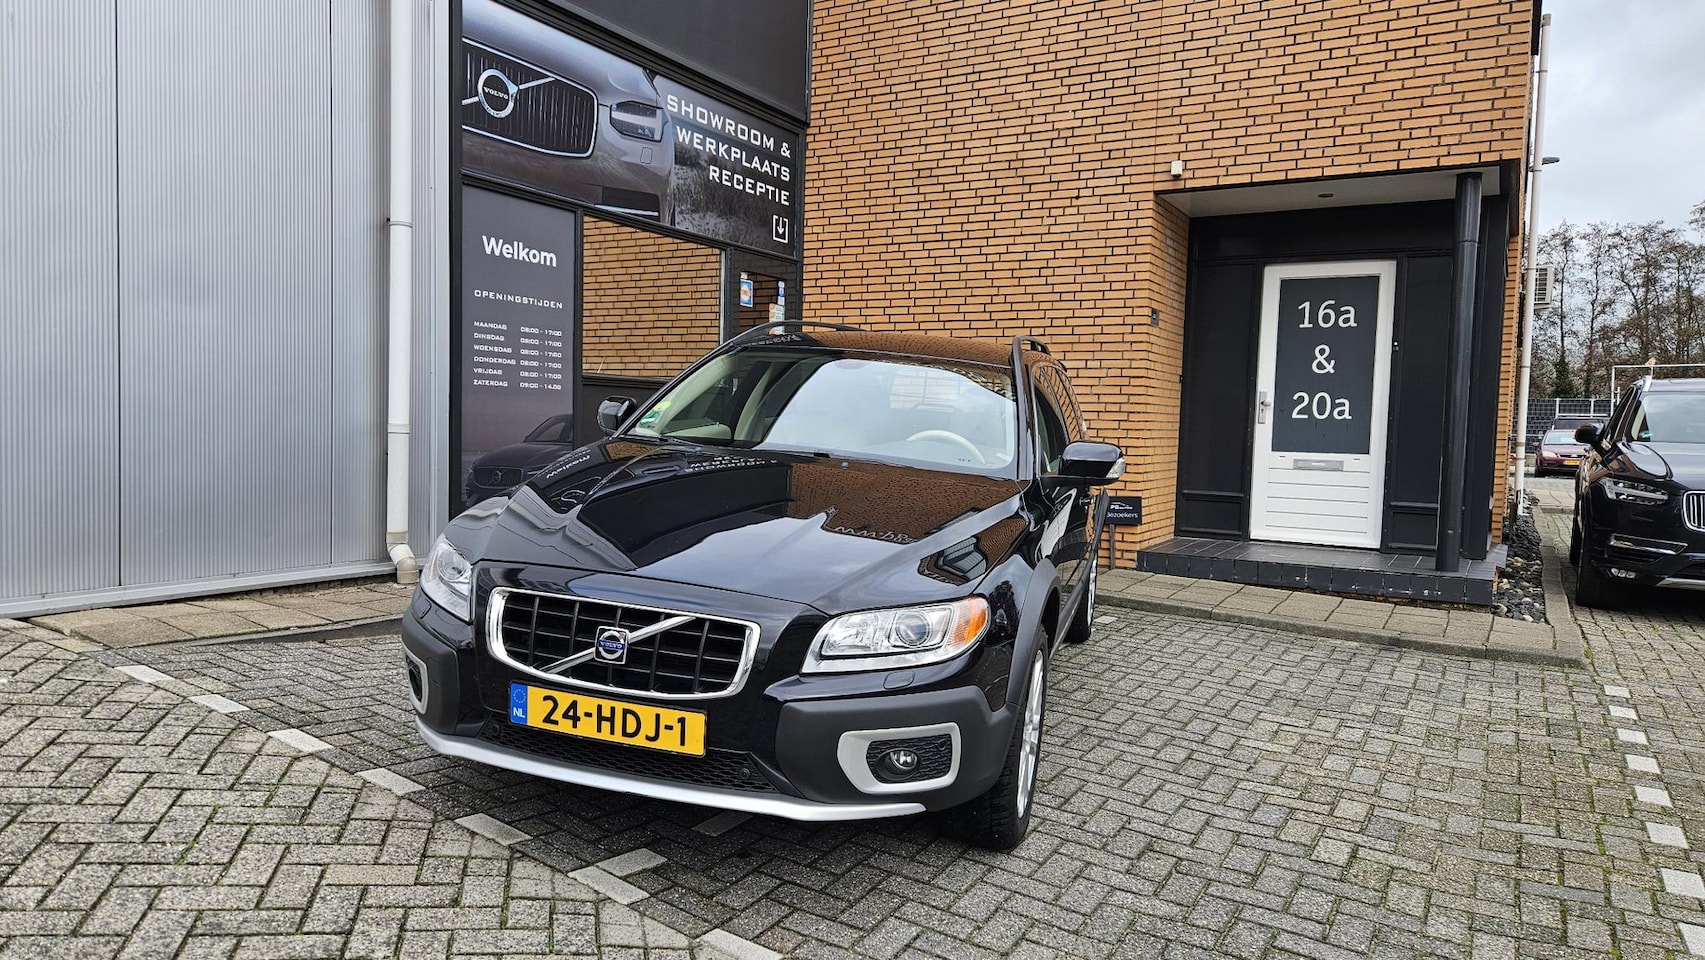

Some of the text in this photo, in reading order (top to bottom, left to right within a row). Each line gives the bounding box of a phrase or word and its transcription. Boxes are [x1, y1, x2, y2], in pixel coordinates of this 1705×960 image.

[483, 86, 509, 100] VOLVO
[666, 95, 791, 158] SHOWROOM &
[676, 126, 790, 182] WERKPLAATS
[709, 165, 790, 206] RECEPTIE
[482, 235, 557, 267] Welkom
[474, 289, 563, 309] OPENINGSTIJDEN
[1298, 300, 1358, 328] 16a
[474, 321, 507, 330] MAANDAG
[473, 333, 505, 341] DINSDAG
[473, 344, 512, 353] WOENSDAG
[473, 356, 516, 365] DONDERDAG
[1311, 344, 1336, 374] &
[473, 367, 503, 375] VRIJDAG
[473, 379, 508, 387] ZATERDAG
[1291, 391, 1352, 420] 20a
[600, 640, 623, 649] VOLVO
[513, 706, 525, 718] NL
[541, 695, 687, 747] 24-HDJ-1
